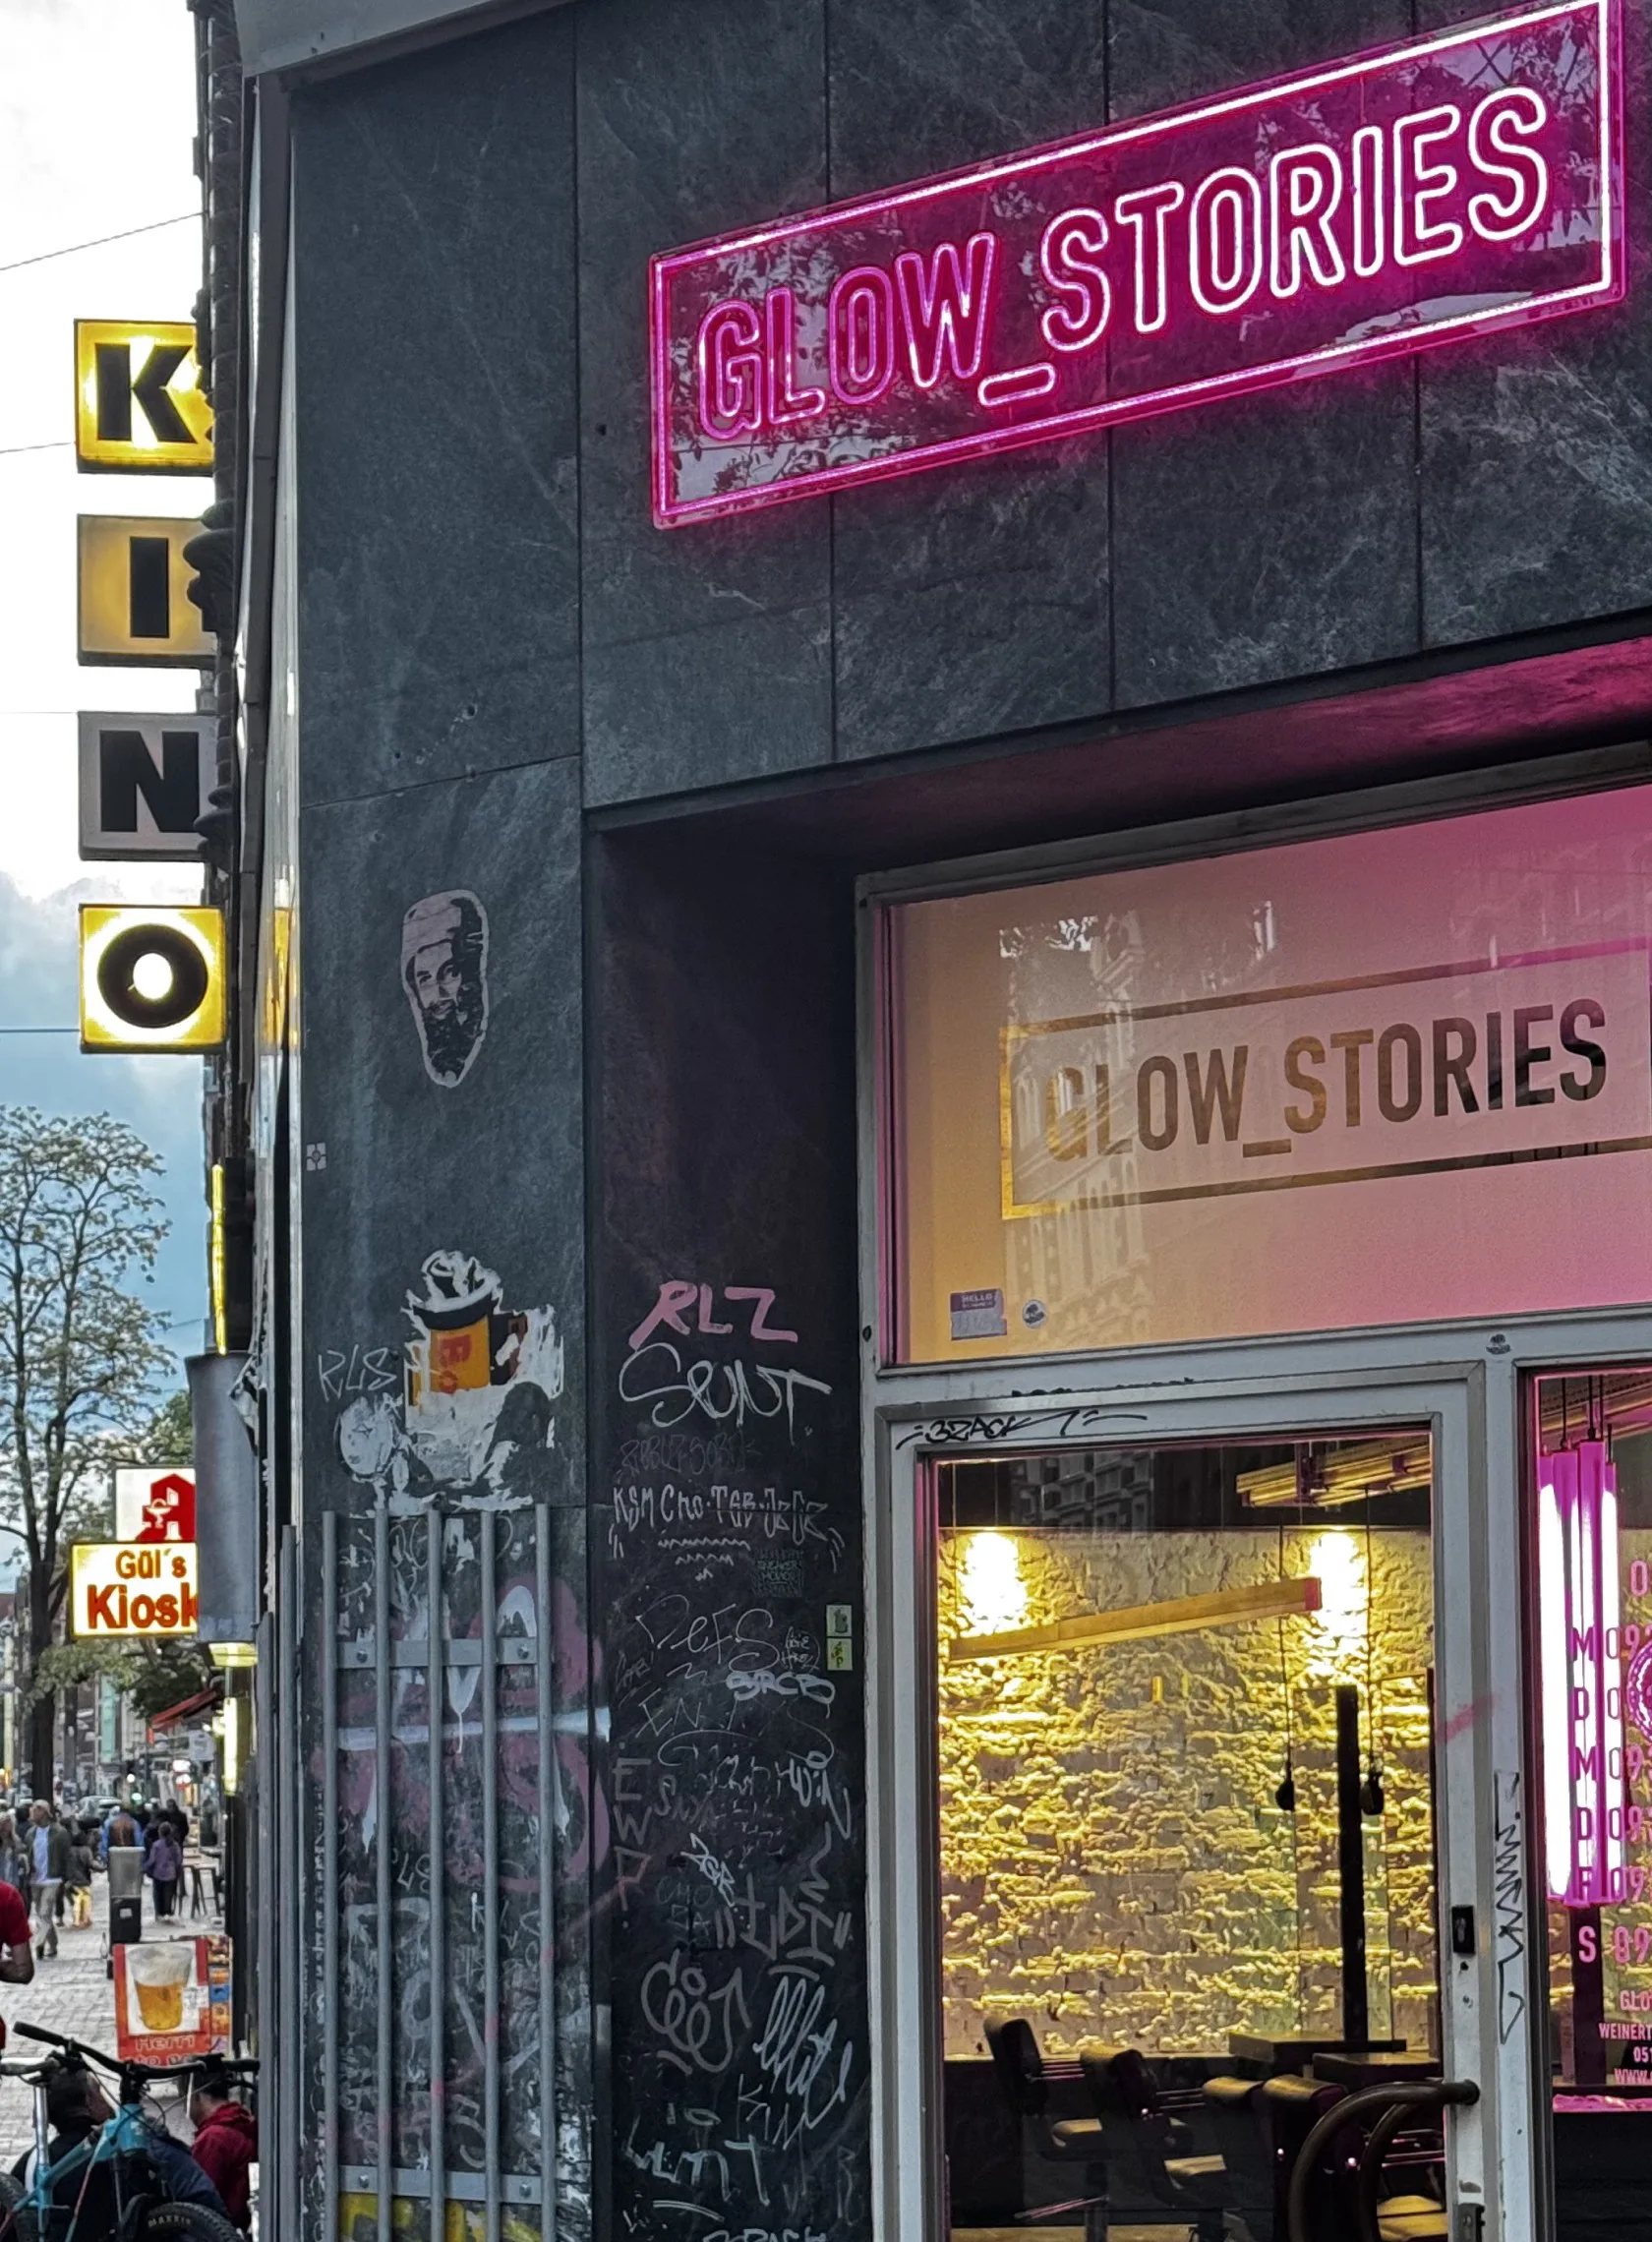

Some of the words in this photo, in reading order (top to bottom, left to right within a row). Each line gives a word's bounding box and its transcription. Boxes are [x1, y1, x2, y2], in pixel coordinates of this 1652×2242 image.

[96, 343, 208, 1029] KINO
[1578, 1925, 1597, 1963] S
[1620, 1989, 1652, 2012] GLO
